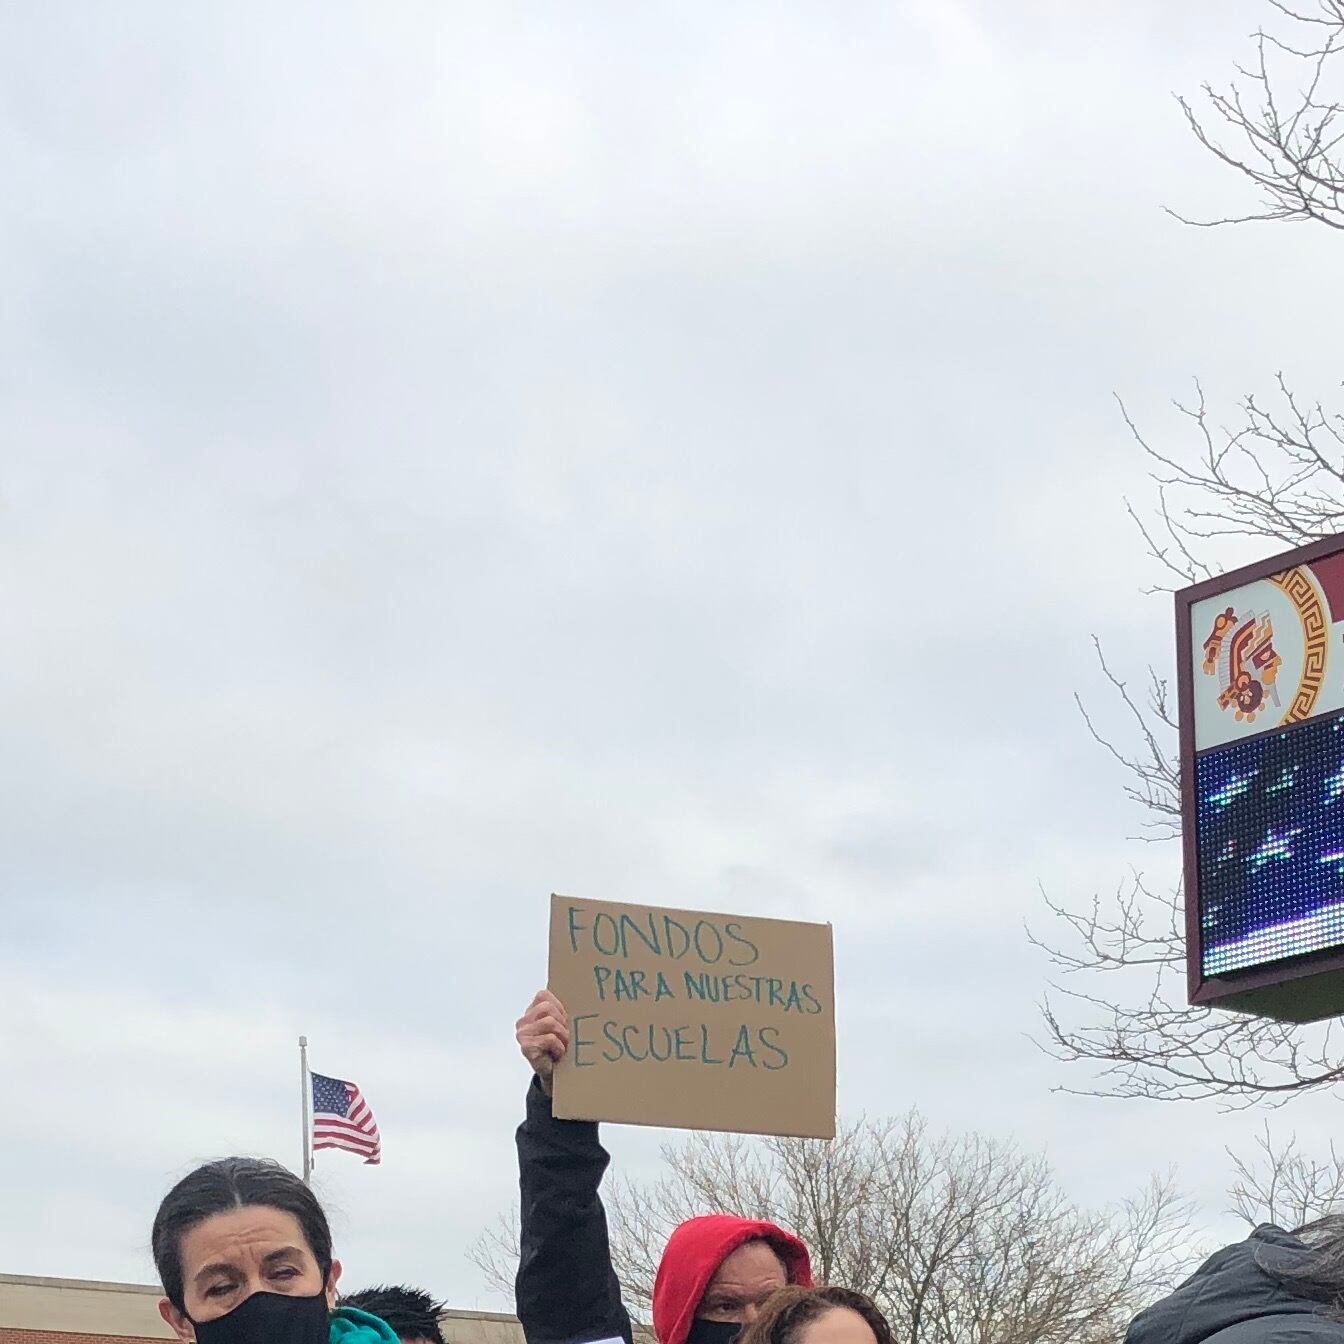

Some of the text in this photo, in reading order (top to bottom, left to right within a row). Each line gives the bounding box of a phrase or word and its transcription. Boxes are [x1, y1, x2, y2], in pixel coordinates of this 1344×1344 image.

[568, 907, 758, 966] FONDOS
[594, 965, 822, 1014] PARA NUESTRAS
[573, 1014, 788, 1070] ESCUELAS
